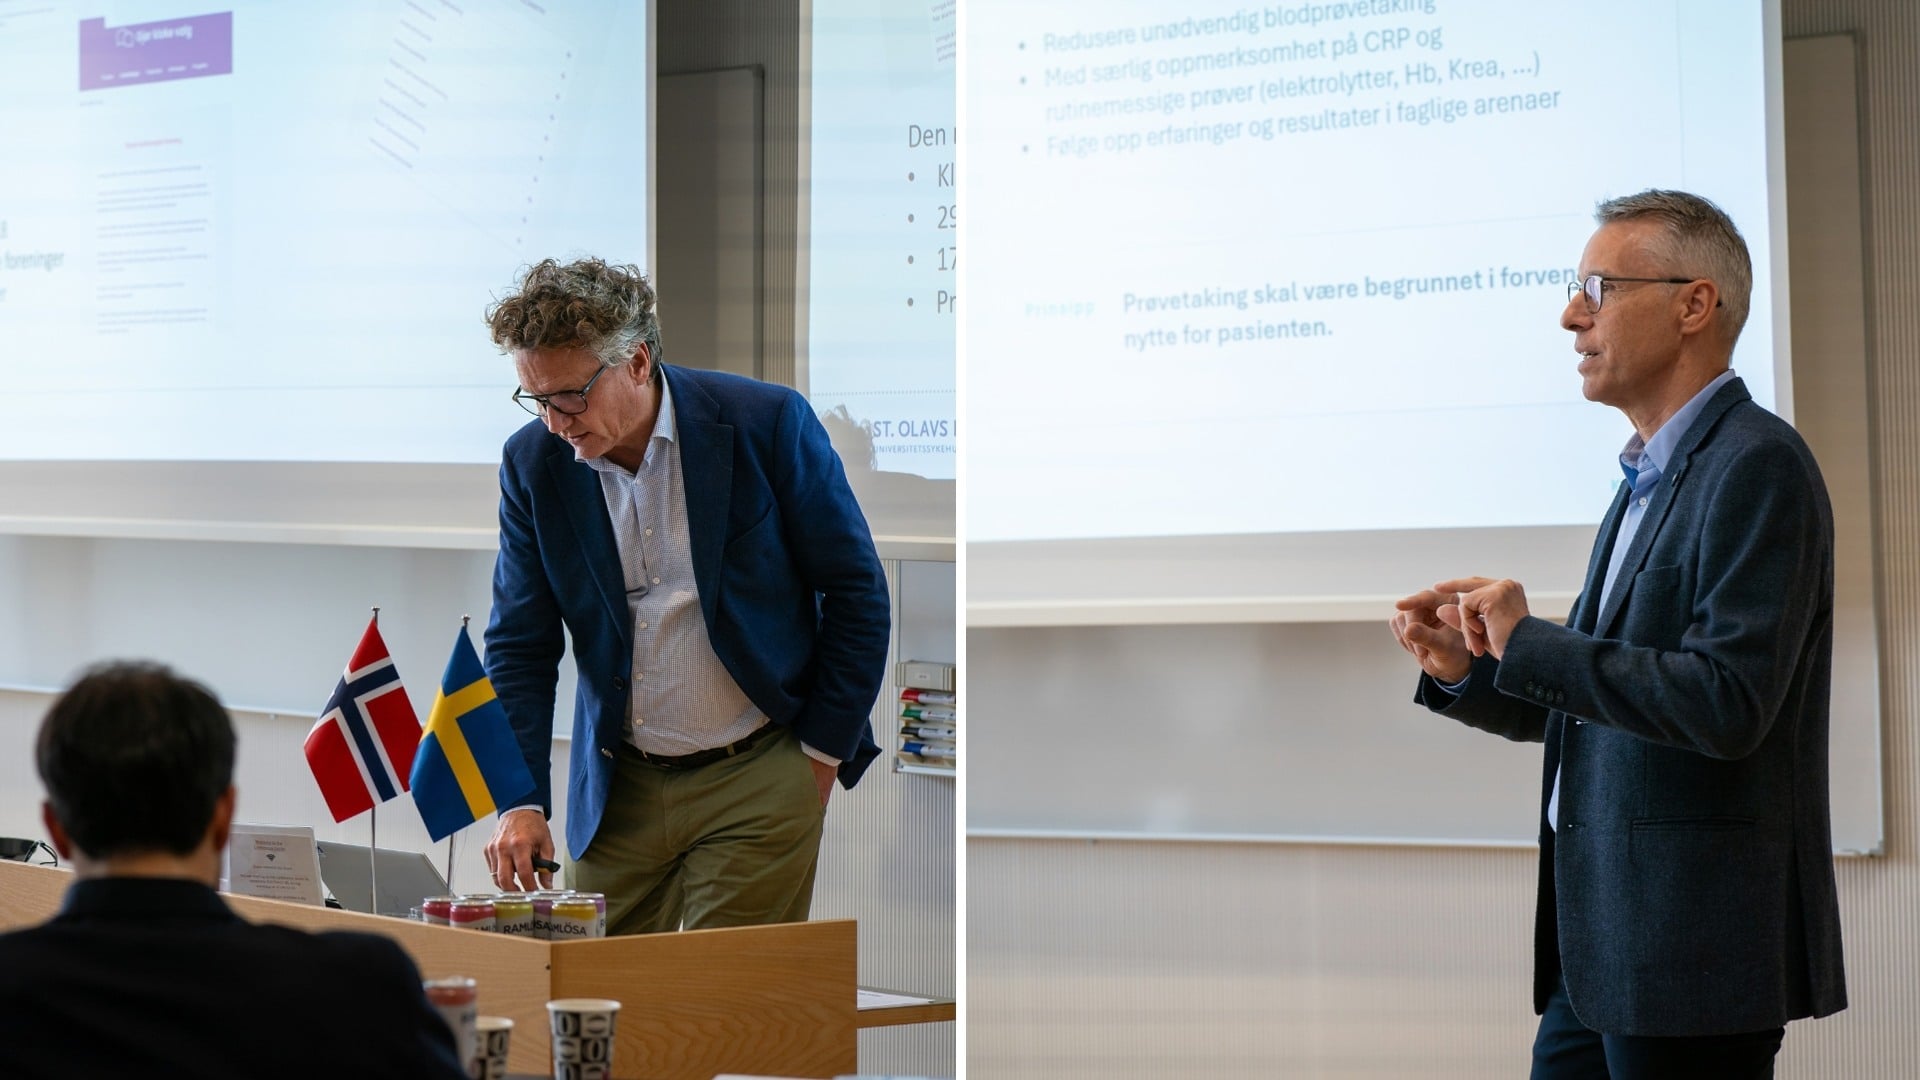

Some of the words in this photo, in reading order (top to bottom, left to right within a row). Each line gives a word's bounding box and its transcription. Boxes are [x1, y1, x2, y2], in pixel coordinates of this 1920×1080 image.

[1043, 26, 1136, 53] Redusere
[1141, 10, 1259, 42] unødvendig
[1264, 0, 1437, 27] blodprøvetaking
[1044, 66, 1086, 87] Med
[1092, 57, 1153, 83] særlig
[1156, 38, 1326, 78] oppmerksomhet
[1332, 32, 1358, 60] på
[1364, 27, 1410, 52] CRP
[1416, 27, 1443, 50] og
[1045, 91, 1185, 122] rutinemessige
[1191, 85, 1254, 110] prøver
[1259, 69, 1399, 104] (elektrolytter,
[1405, 64, 1443, 85] Hb,
[1449, 58, 1505, 81] Krea,
[909, 124, 946, 148] Den
[1047, 135, 1098, 159] Følge
[1104, 132, 1141, 154] opp
[1147, 121, 1243, 146] erfaringer
[1249, 117, 1274, 140] og
[1278, 105, 1380, 133] resultater
[1397, 97, 1468, 125] faglige
[1474, 89, 1561, 116] arenaer
[1123, 286, 1249, 312] Prøvetaking
[1254, 281, 1298, 305] skal
[1304, 280, 1358, 300] være
[1364, 270, 1482, 299] begrunnet
[1124, 328, 1177, 351] nytte
[1183, 324, 1212, 344] for
[1218, 319, 1333, 347] pasienten.
[873, 421, 895, 438] ST.
[898, 420, 948, 438] OLAVS
